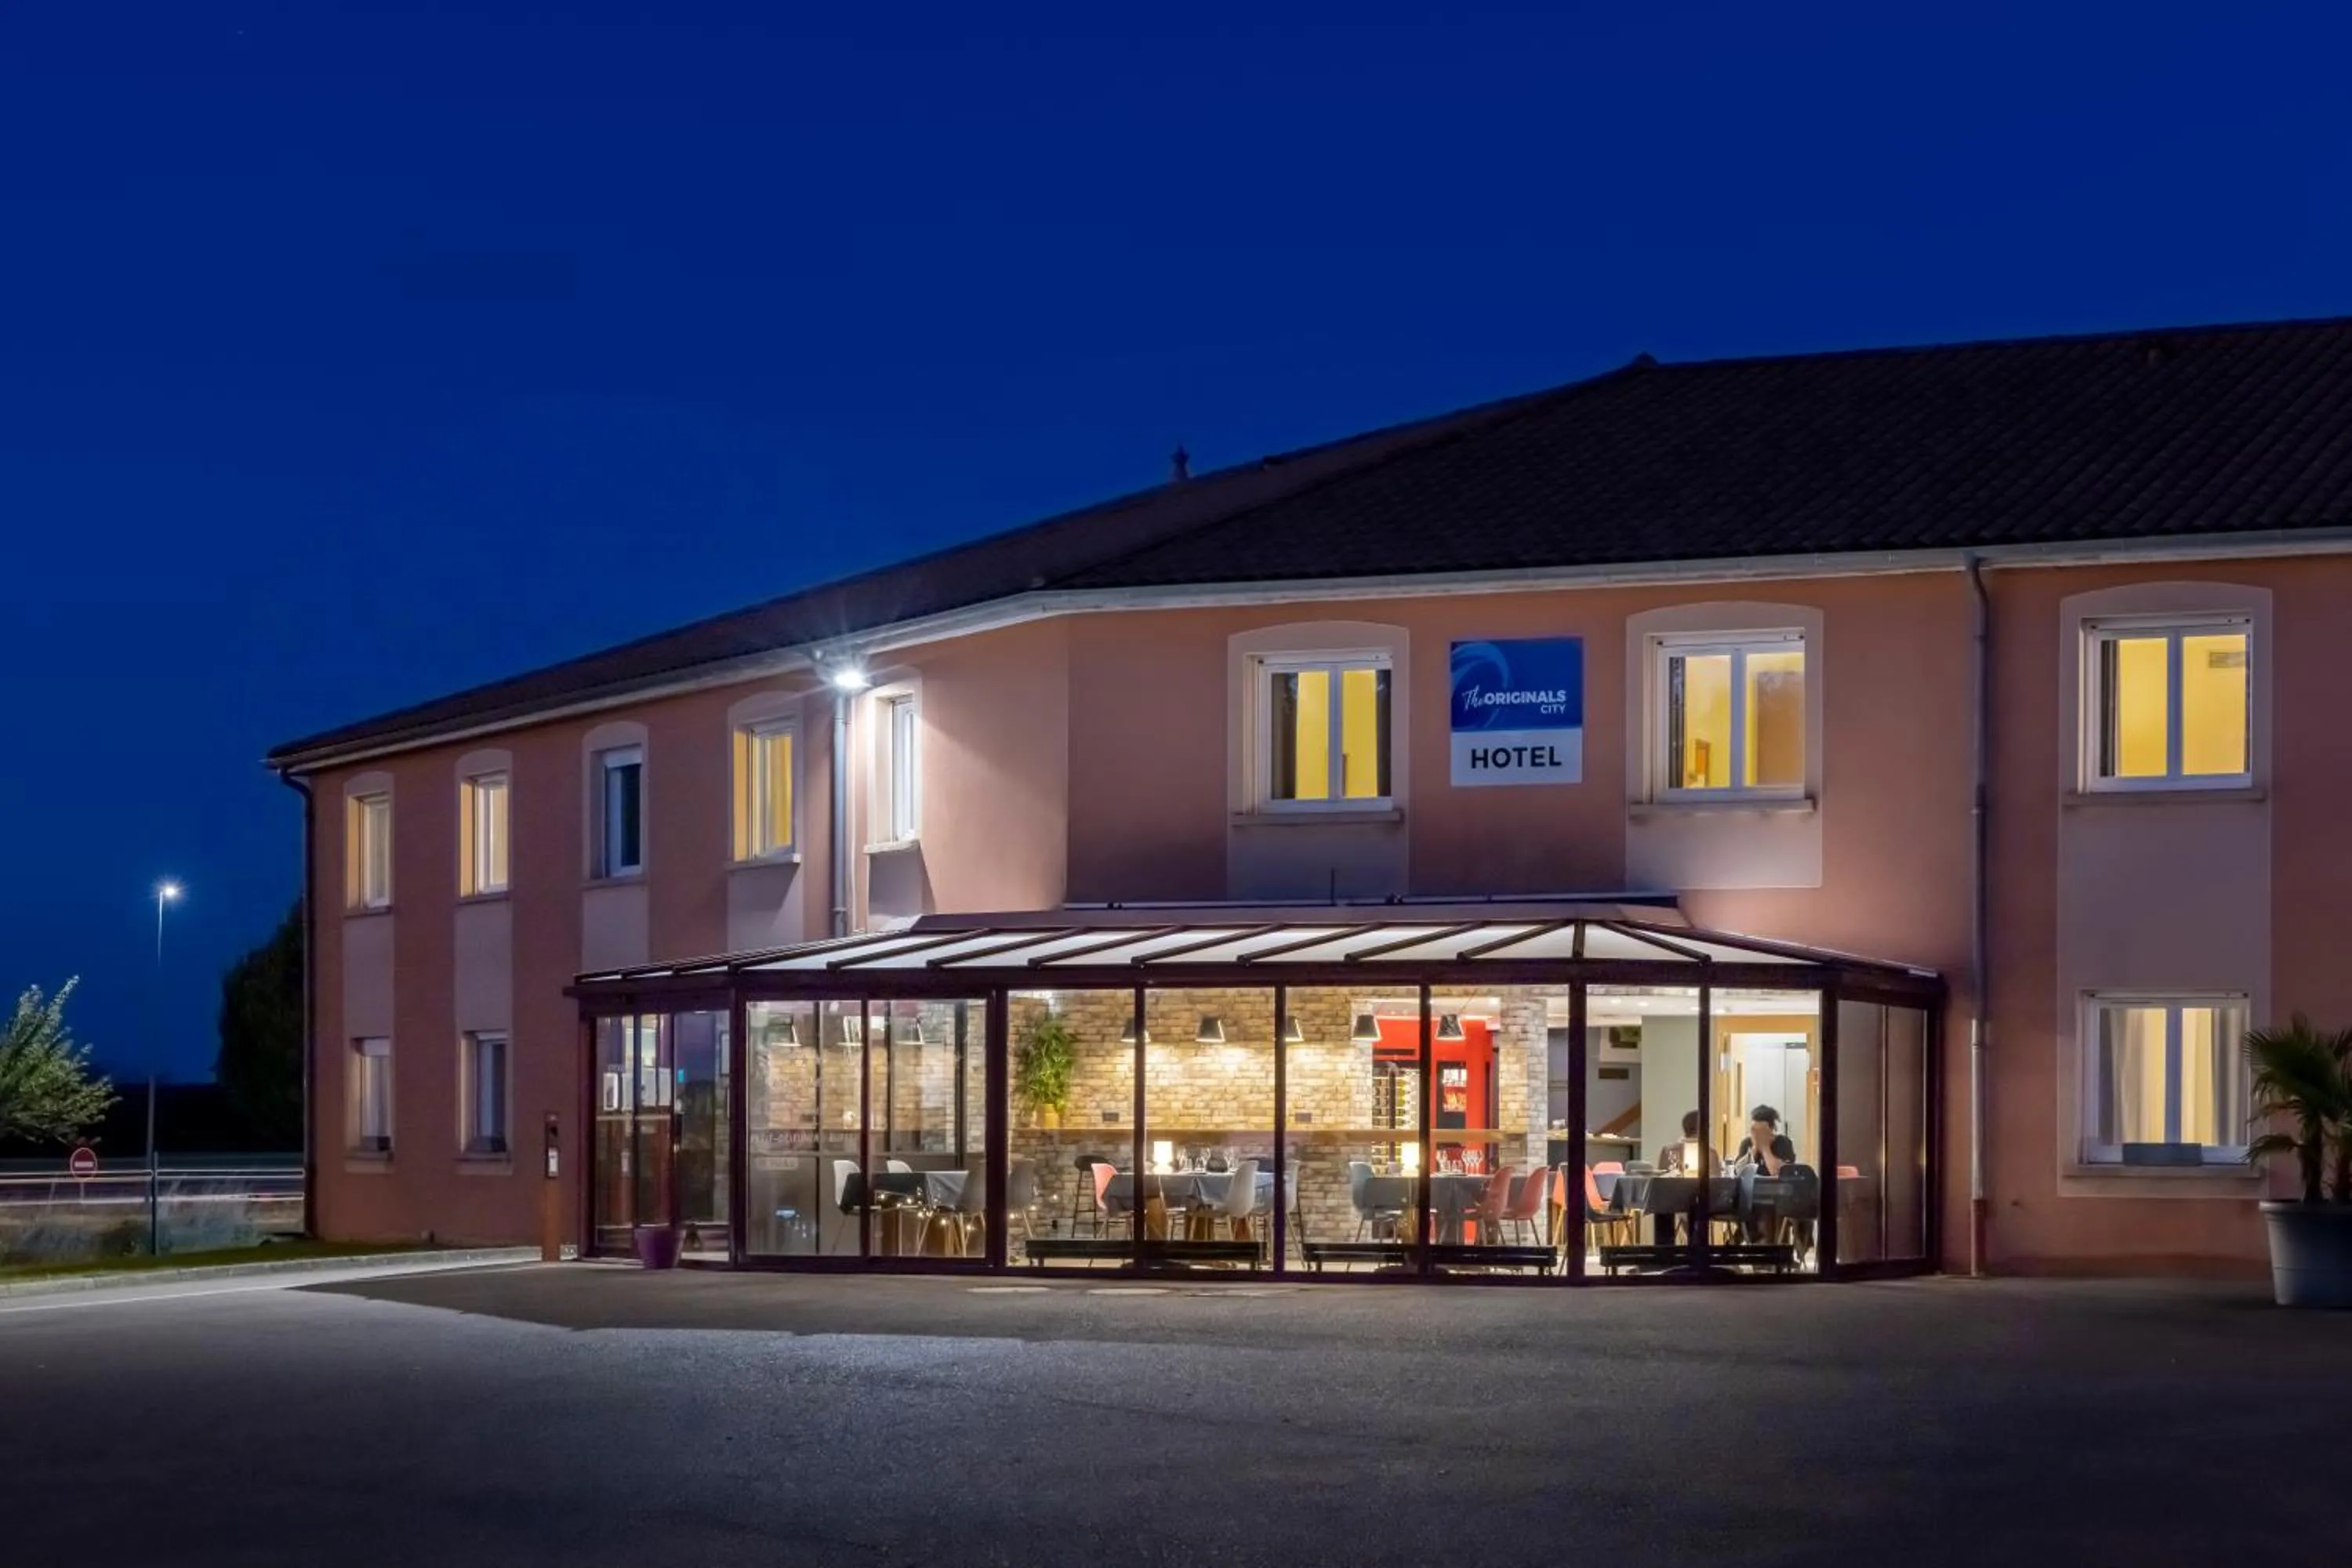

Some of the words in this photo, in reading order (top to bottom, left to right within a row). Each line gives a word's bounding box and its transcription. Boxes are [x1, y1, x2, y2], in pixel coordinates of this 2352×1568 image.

[1462, 685, 1484, 711] The
[1484, 689, 1566, 705] ORIGINALS
[1541, 704, 1566, 714] CITY
[1471, 746, 1562, 769] HOTEL
